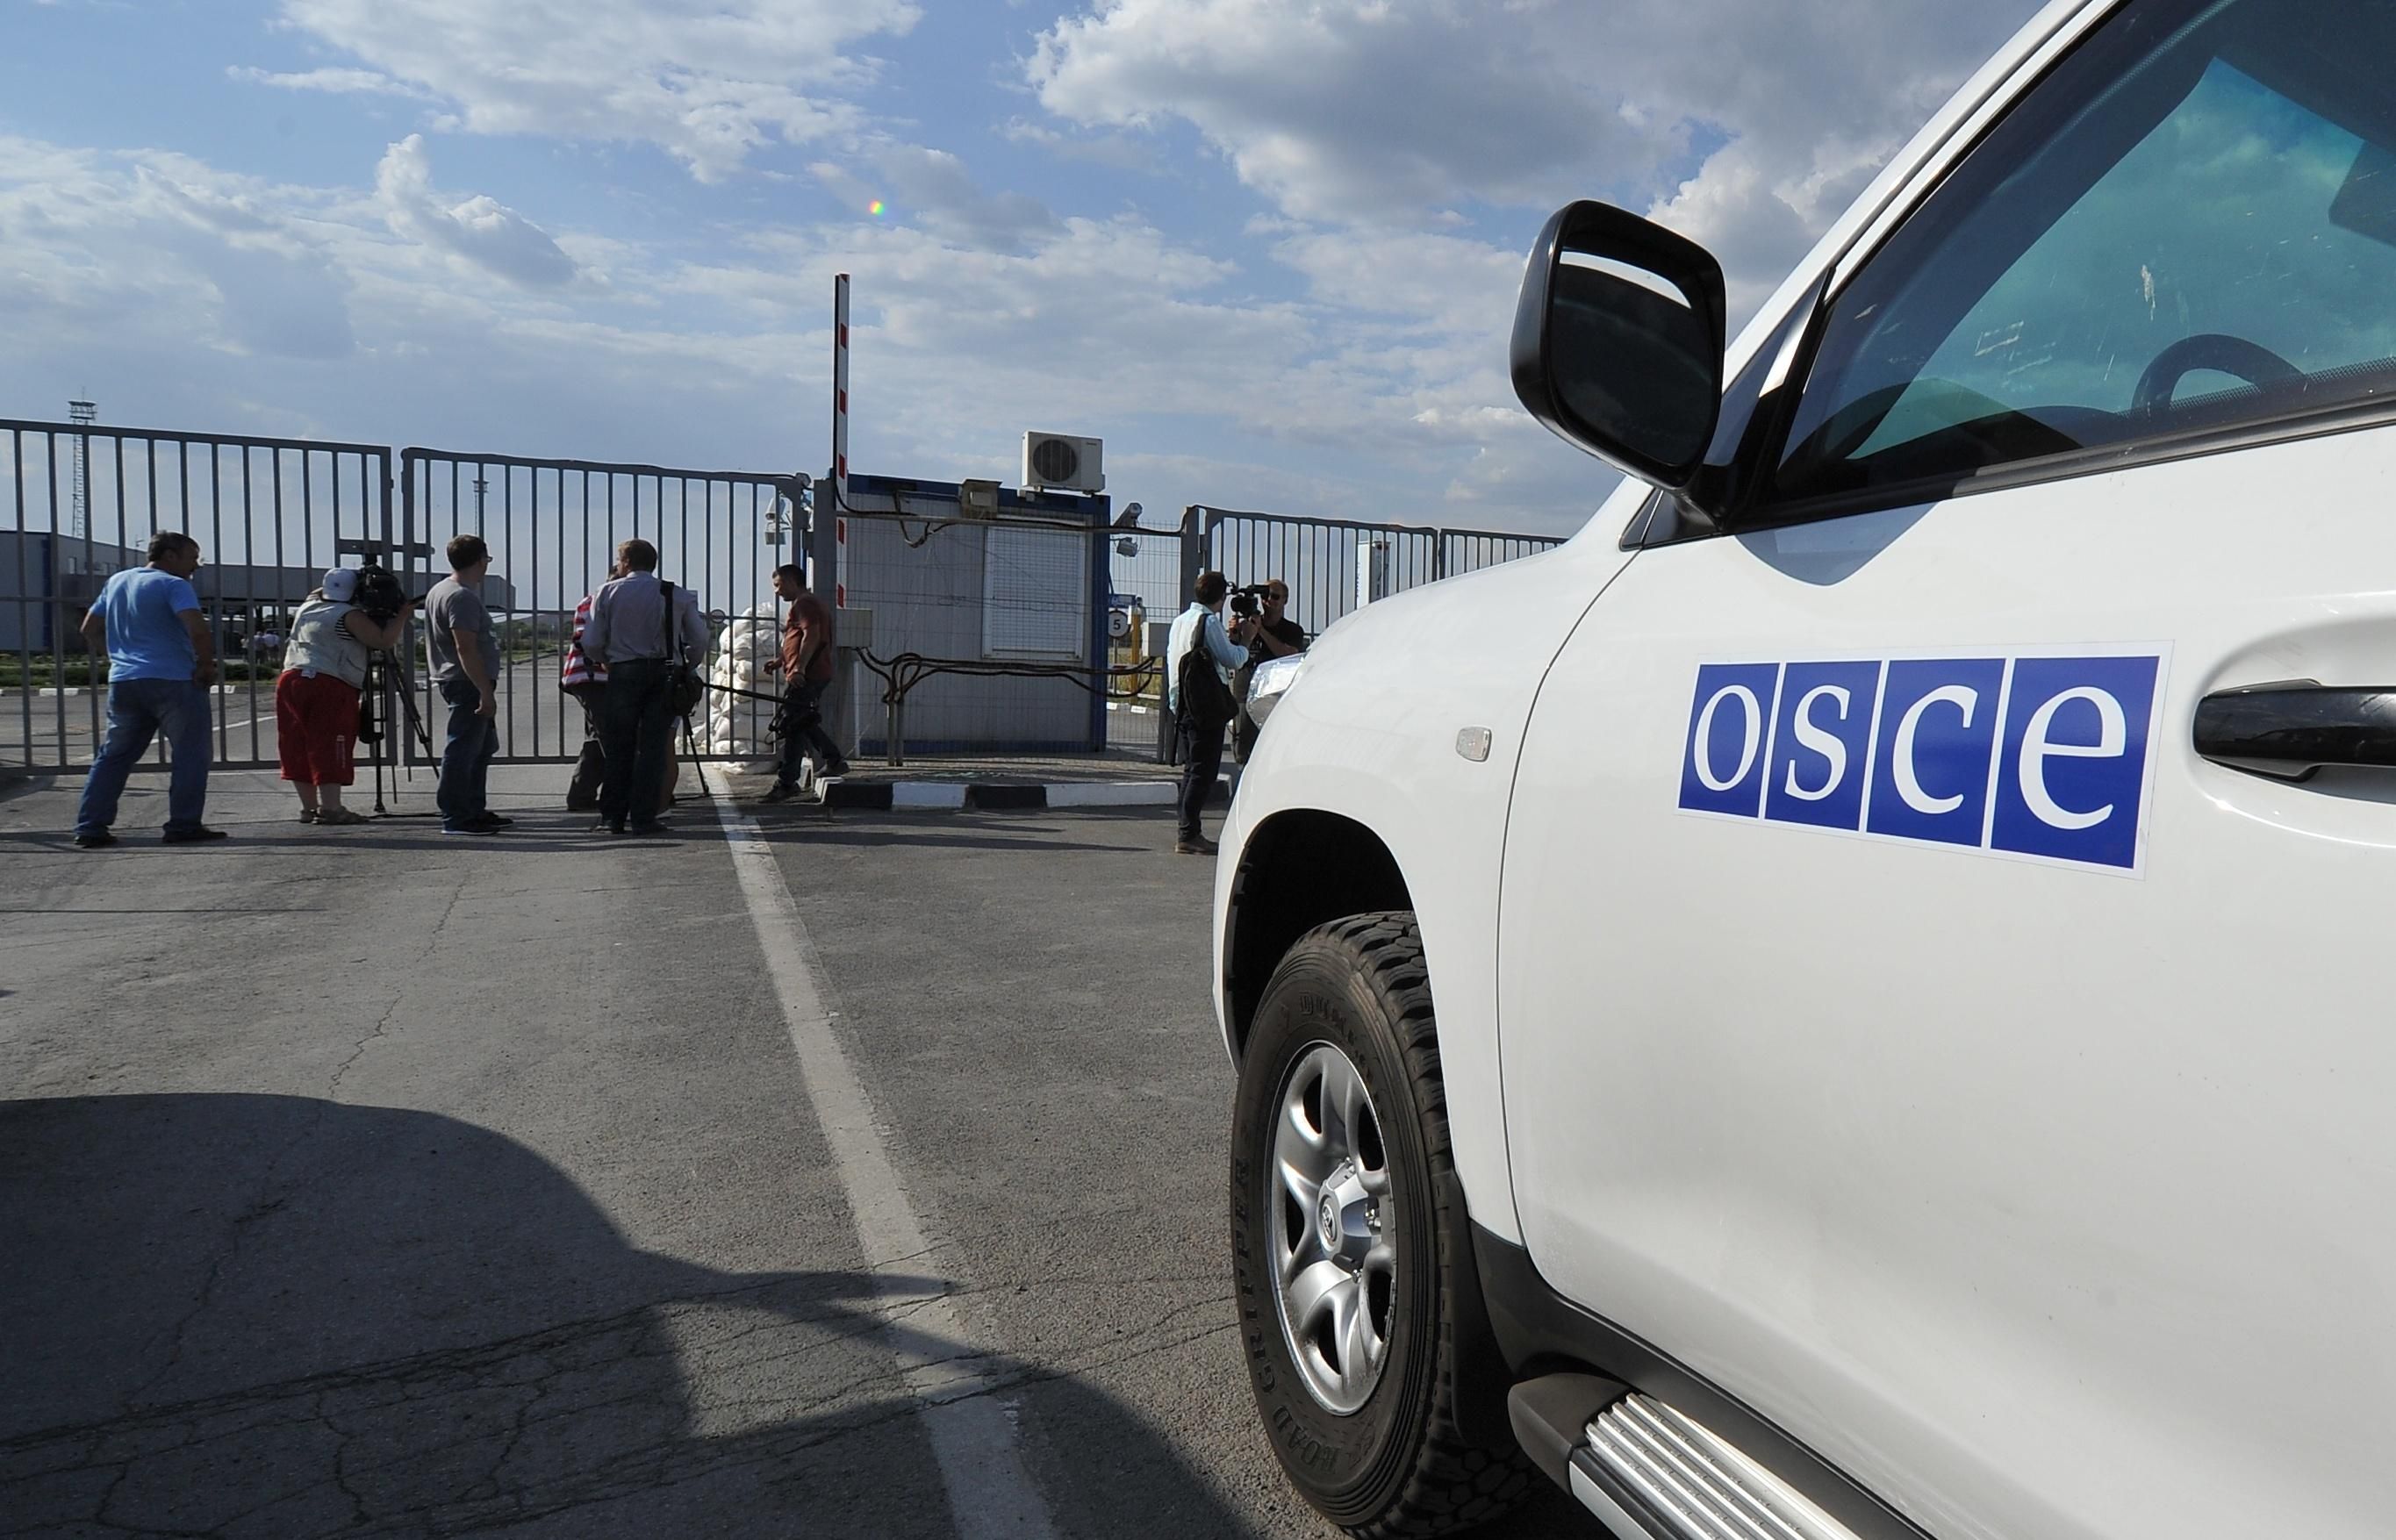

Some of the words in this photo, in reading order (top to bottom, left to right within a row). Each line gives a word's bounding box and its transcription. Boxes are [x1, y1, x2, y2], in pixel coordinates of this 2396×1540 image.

[1113, 619, 1121, 630] 5
[1234, 1157, 1278, 1393] GRIPPER
[1272, 1404, 1341, 1476] ROAD
